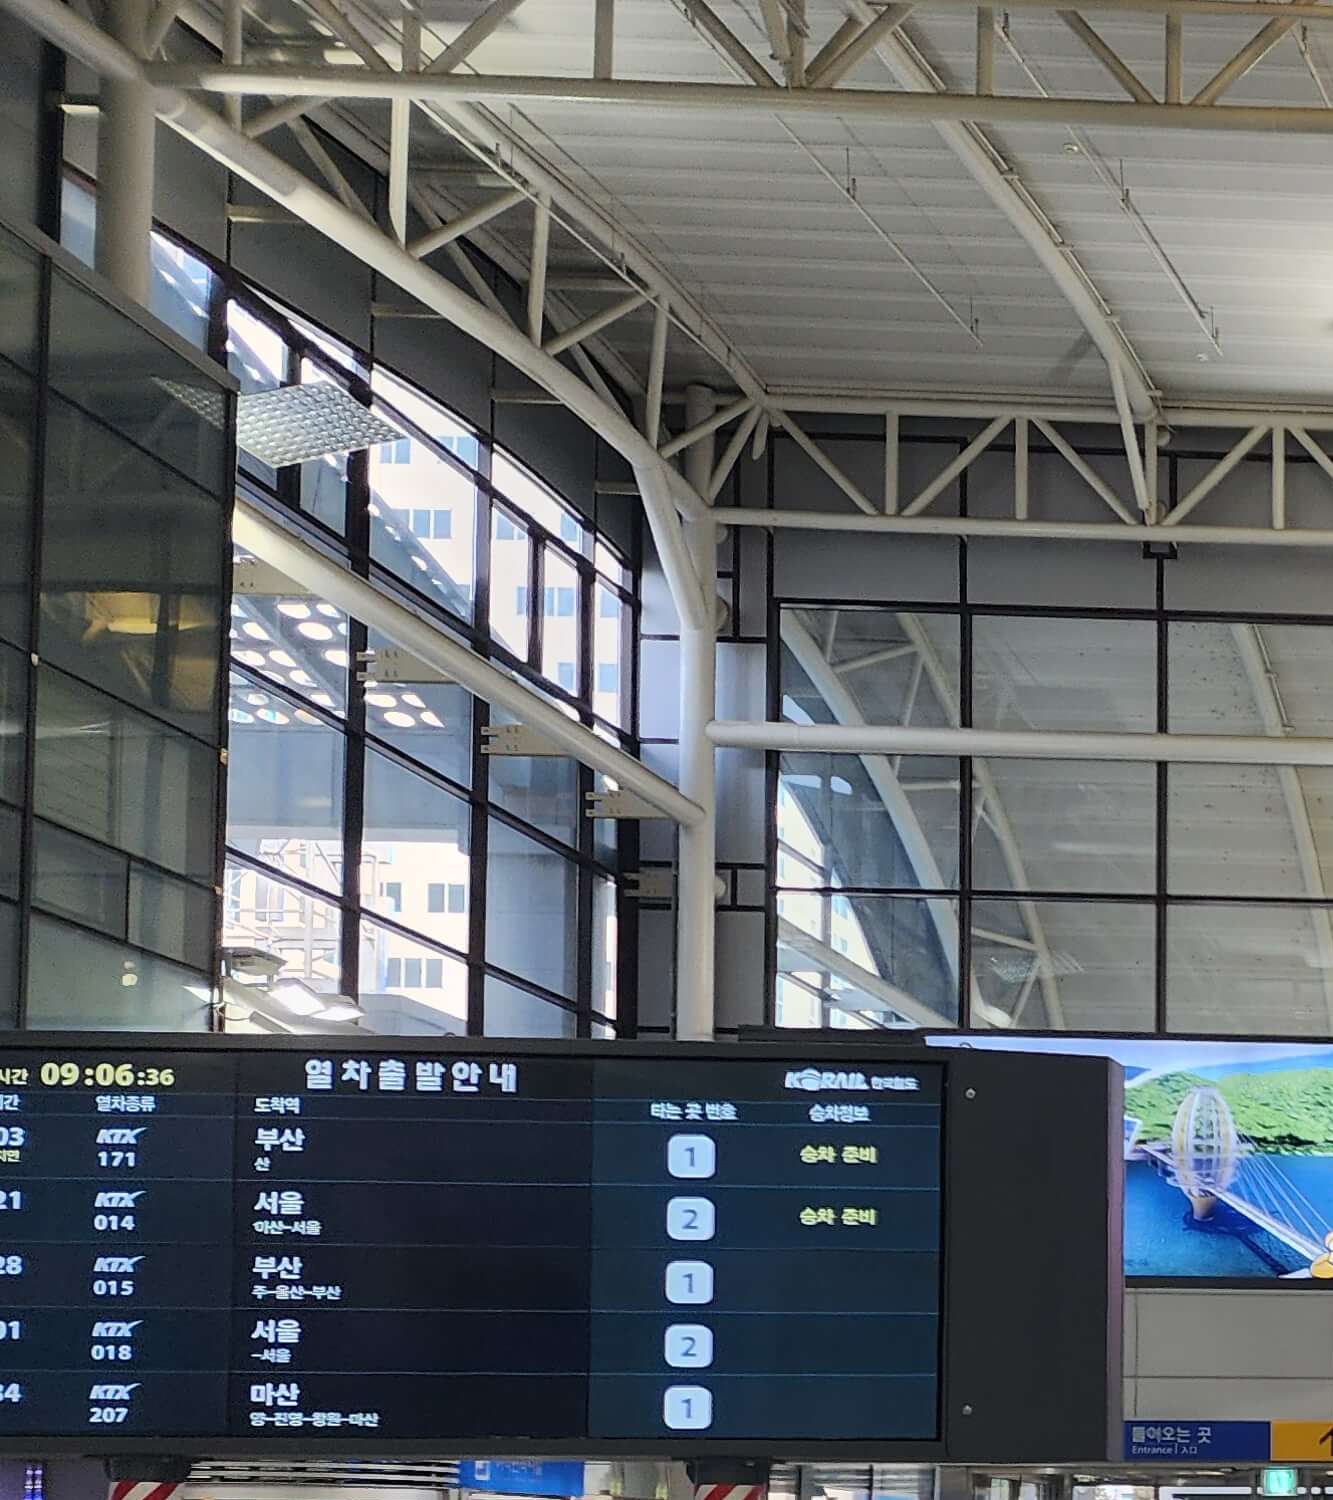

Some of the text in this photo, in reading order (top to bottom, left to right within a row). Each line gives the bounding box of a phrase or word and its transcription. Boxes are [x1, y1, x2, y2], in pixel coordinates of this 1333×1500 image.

[40, 1062, 175, 1086] 09:06:36
[785, 1068, 869, 1091] KORAIL
[95, 1096, 156, 1112] 열차종류
[254, 1097, 300, 1114] 도착역
[651, 1102, 738, 1120] 타는 곳 번호
[809, 1104, 871, 1123] 승차정보
[96, 1127, 147, 1144] KTX
[254, 1128, 305, 1151] 부산
[97, 1151, 136, 1167] 171
[684, 1146, 696, 1168] 1
[800, 1145, 878, 1164] 승차 준비
[253, 1156, 272, 1172] 산
[94, 1190, 147, 1208] KTX
[253, 1190, 305, 1215] 서울
[93, 1214, 136, 1231] 014
[681, 1208, 699, 1230] 2
[799, 1207, 878, 1226] 승차 준비
[93, 1255, 146, 1273] KTX
[252, 1256, 303, 1280] 부산
[92, 1279, 135, 1296] 015
[682, 1272, 695, 1294] 1
[91, 1319, 144, 1337] KTX
[251, 1318, 302, 1343] 서울
[90, 1344, 133, 1361] 018
[680, 1336, 697, 1358] 2
[89, 1382, 142, 1400] KTX
[250, 1382, 300, 1407] 마산
[88, 1407, 129, 1424] 207
[681, 1398, 694, 1420] 1
[1132, 1426, 1212, 1444] 들어오는 곳
[1132, 1445, 1197, 1454] Entrance 入口
